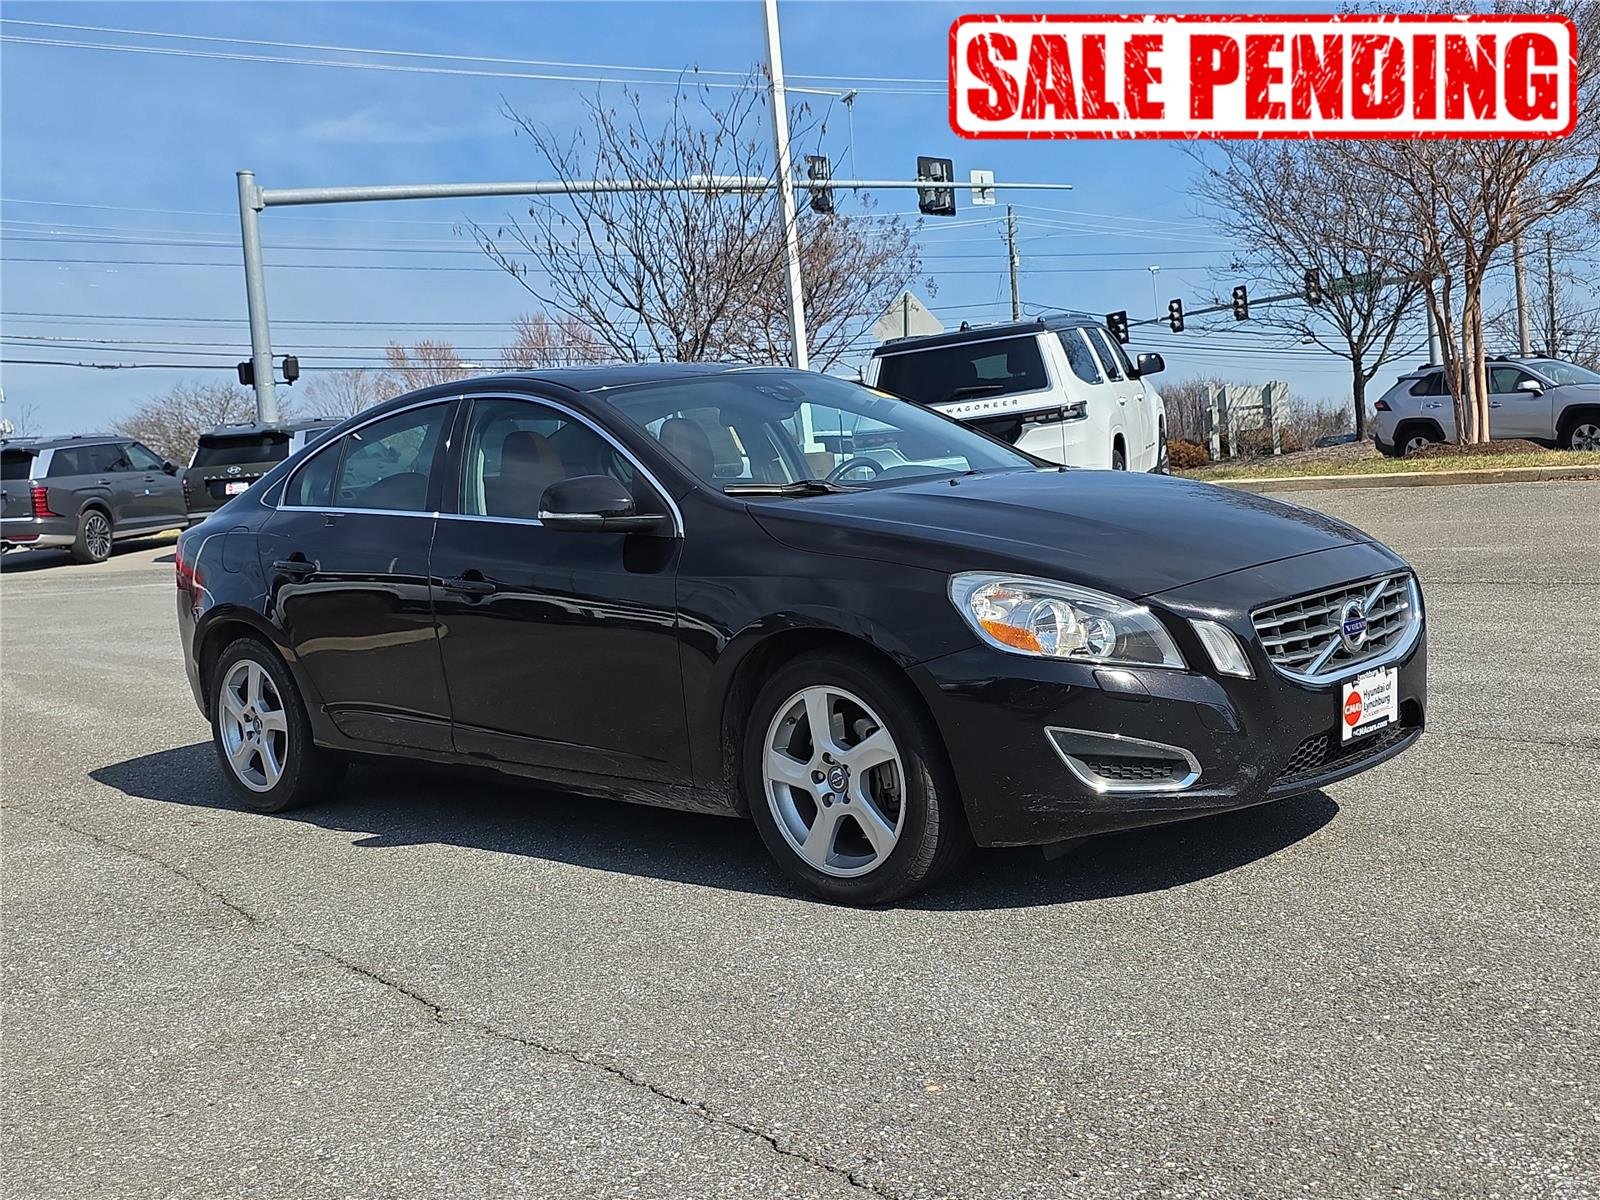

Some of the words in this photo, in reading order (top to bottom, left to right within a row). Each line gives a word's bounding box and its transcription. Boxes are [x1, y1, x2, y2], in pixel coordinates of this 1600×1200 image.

[946, 399, 1018, 414] WAGONEER
[1345, 621, 1366, 632] VOLVO
[1363, 683, 1386, 700] Hyundai
[1386, 681, 1392, 691] of
[1363, 695, 1391, 712] Lynchburg
